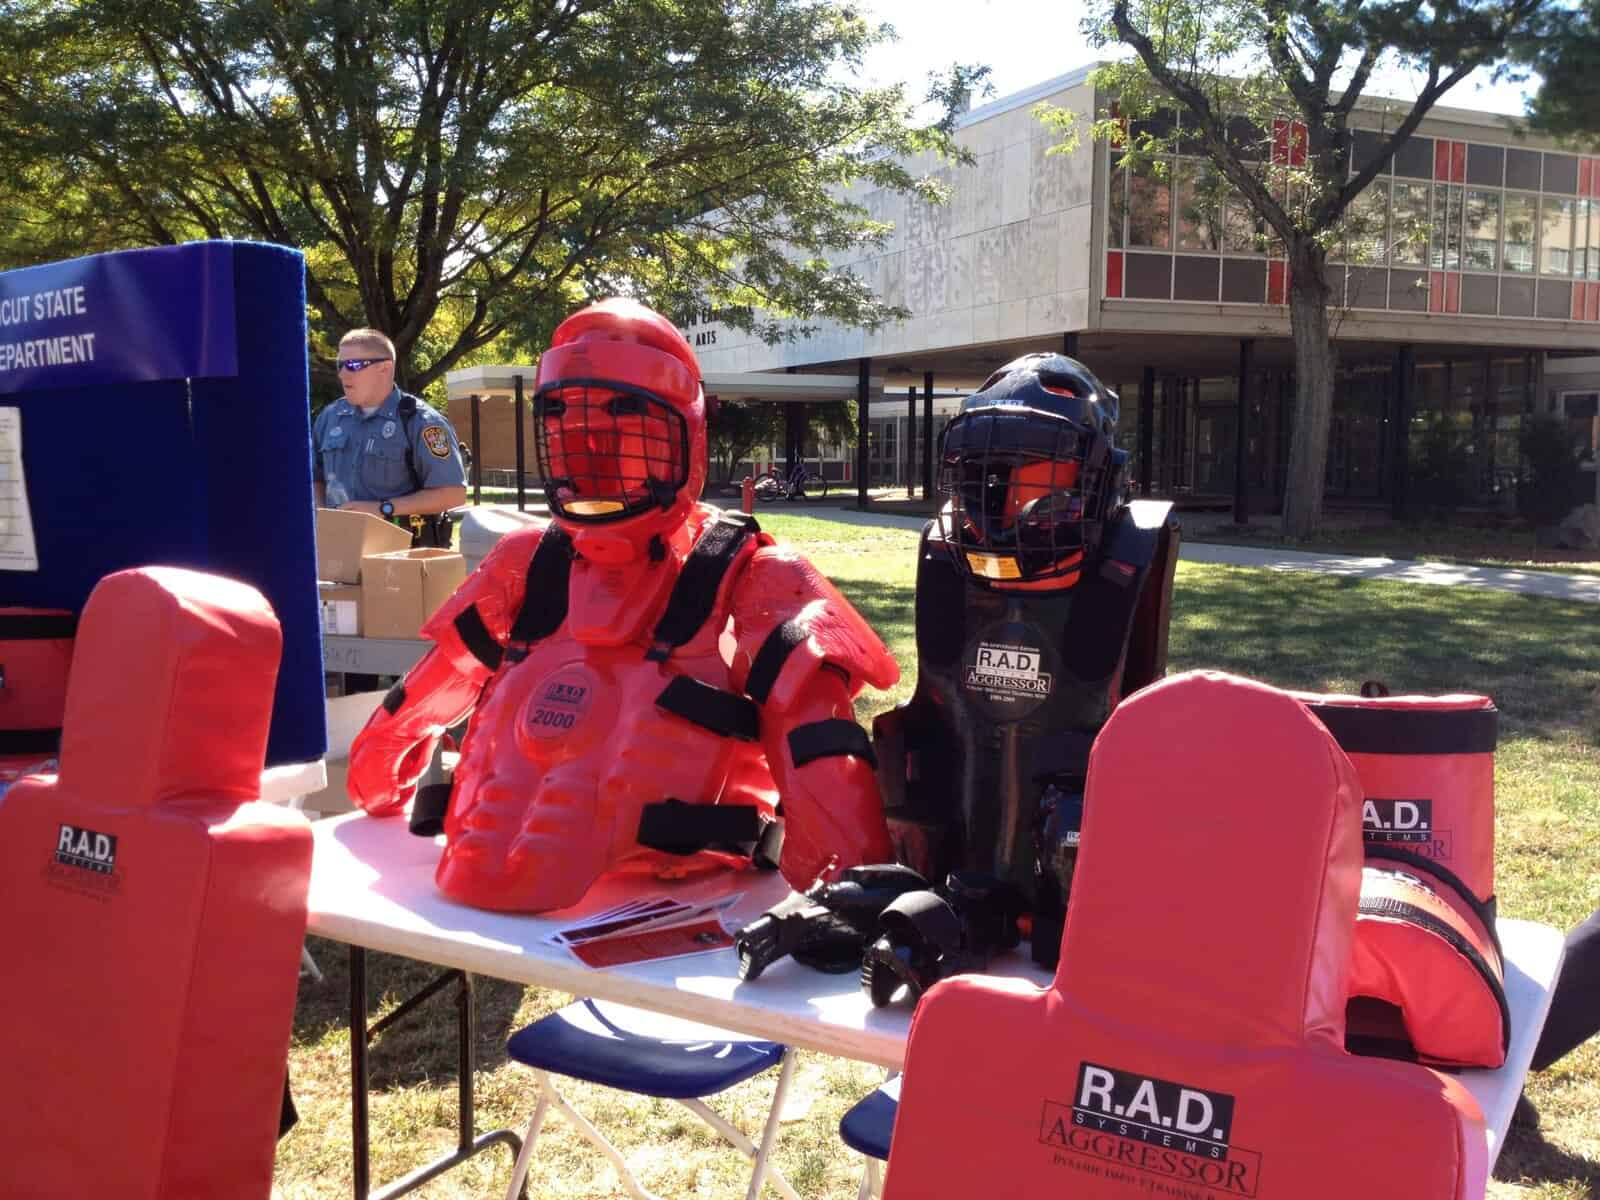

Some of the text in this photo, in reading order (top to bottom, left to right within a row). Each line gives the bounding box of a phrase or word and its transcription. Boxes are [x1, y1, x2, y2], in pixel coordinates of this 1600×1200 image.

[34, 286, 87, 321] STATE
[695, 331, 717, 347] ARTS
[978, 649, 1036, 672] R.A.D.
[967, 671, 1047, 691] AGGRESSOR
[532, 709, 576, 729] 2000
[58, 825, 114, 863] R.A.D.
[1080, 1065, 1224, 1140] R.A.D.
[1076, 1112, 1221, 1159] SYSTEMS
[1047, 1115, 1248, 1193] AGGRESSOR
